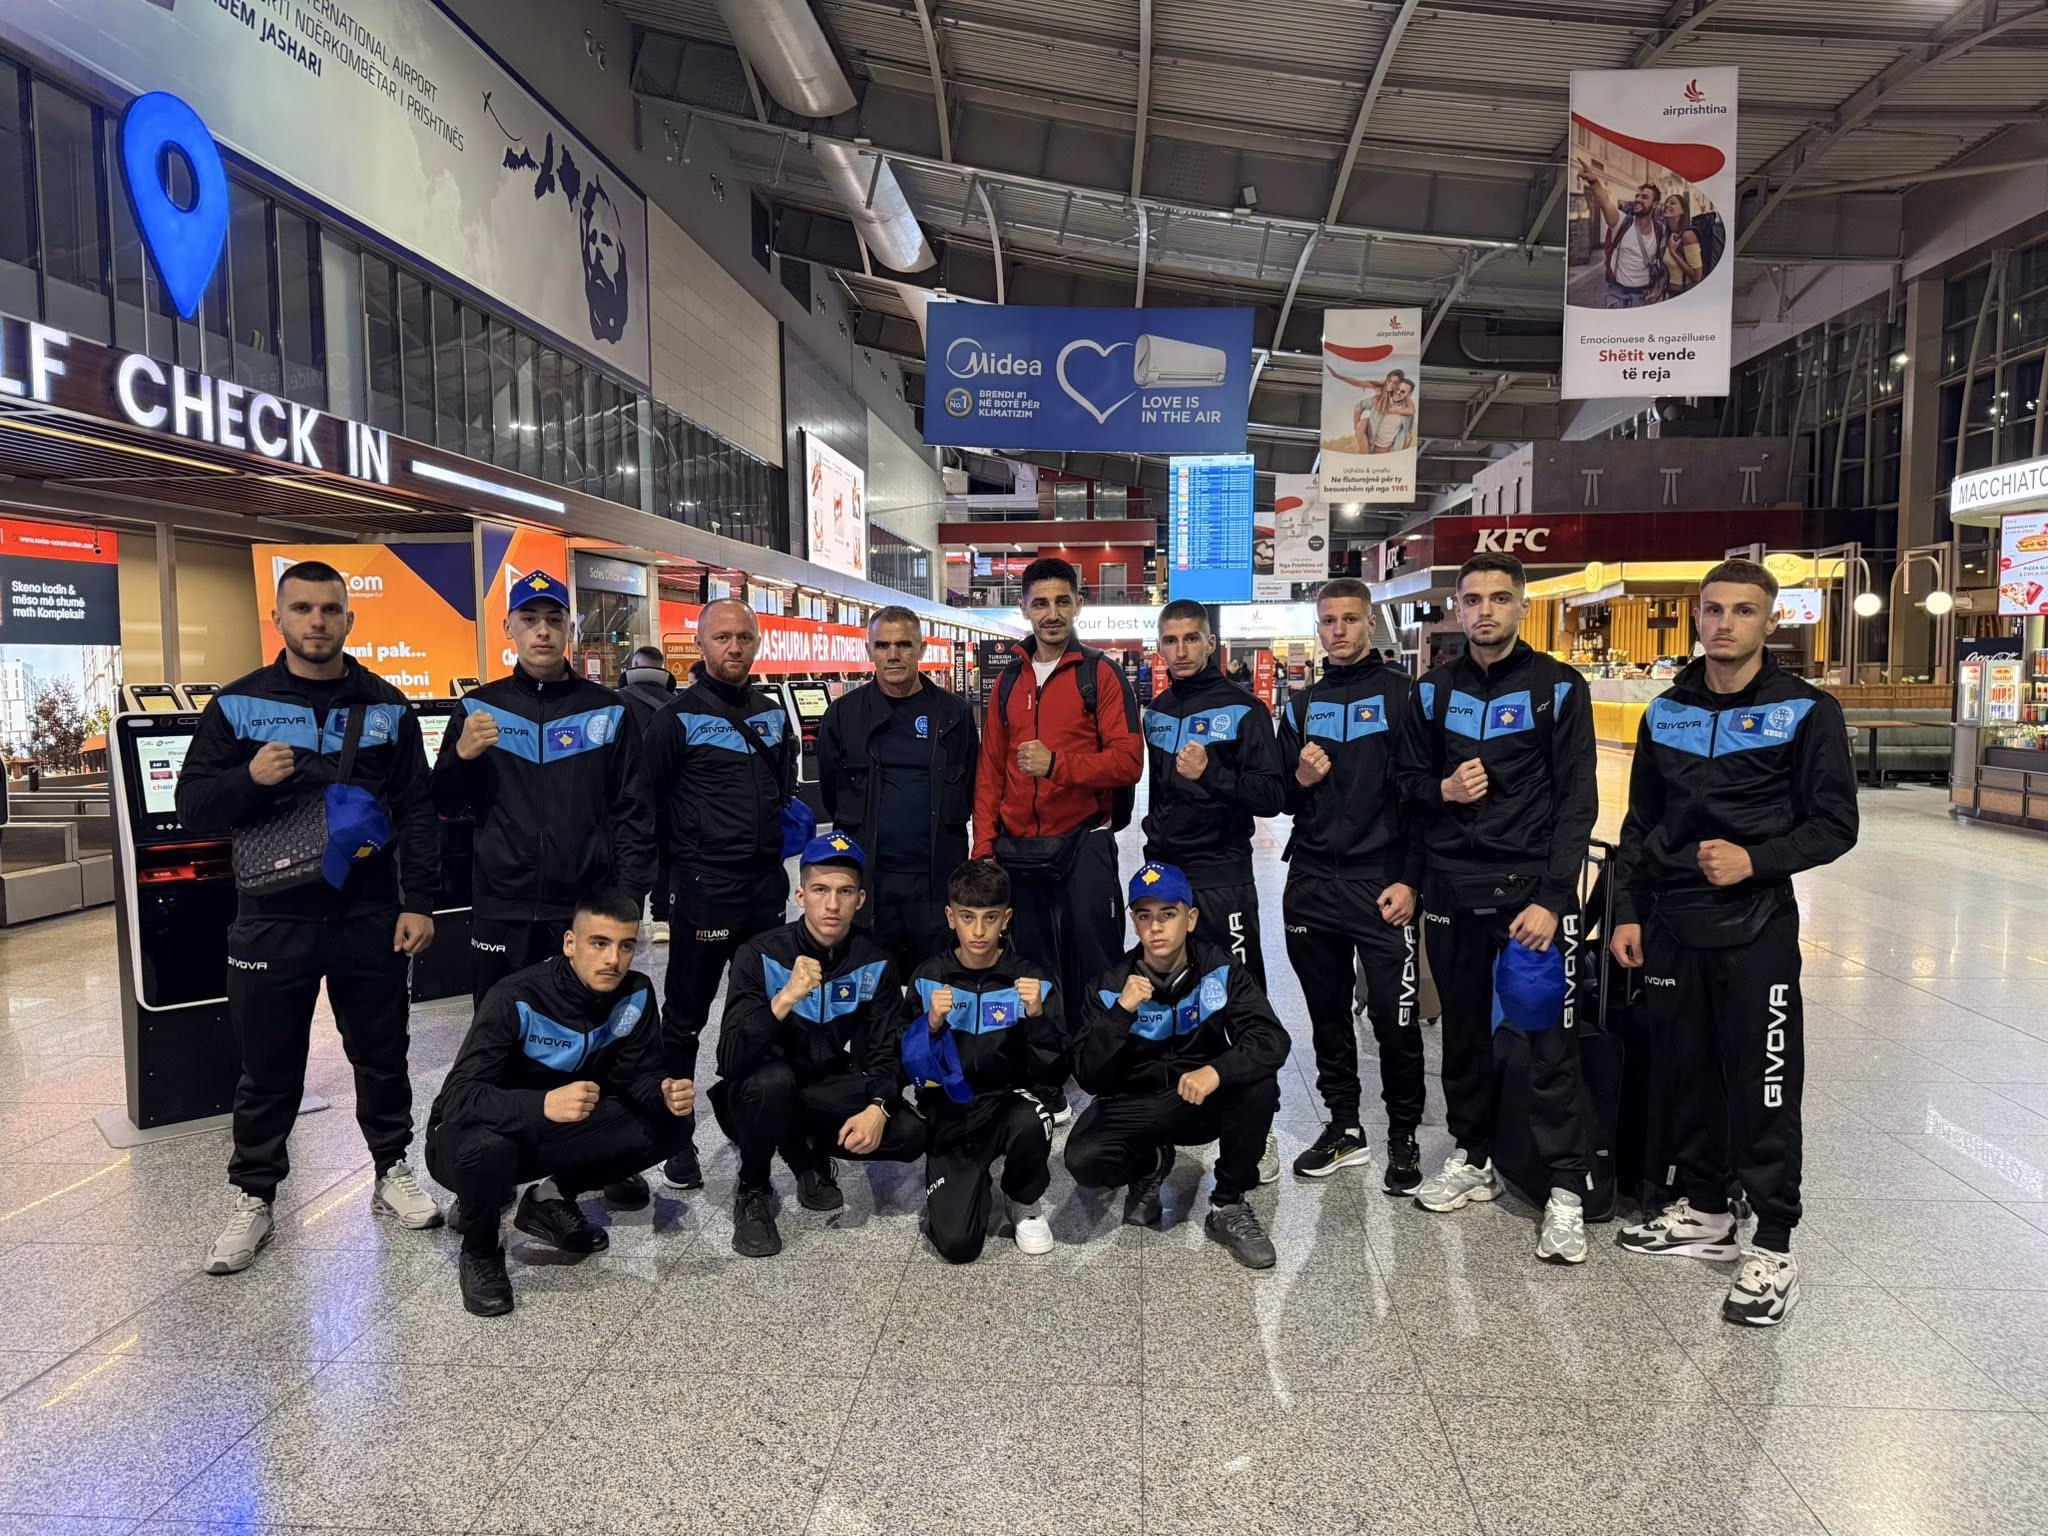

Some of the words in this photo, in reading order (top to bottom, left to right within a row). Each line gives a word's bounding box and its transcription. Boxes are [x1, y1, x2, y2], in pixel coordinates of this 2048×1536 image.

[260, 18, 321, 77] JASHARI
[306, 0, 388, 66] ERNATIONAL
[392, 56, 437, 103] AIRPORT
[295, 8, 396, 101] NDËRKOMBËTAR
[400, 89, 404, 107] I
[407, 94, 464, 152] PRISHTINËS
[1662, 104, 1728, 117] airprishtina
[1580, 335, 1645, 344] Emocionuese
[1647, 334, 1655, 343] &
[1658, 333, 1716, 344] ngazëlluese
[1599, 349, 1644, 362] Shëtit
[1648, 347, 1696, 360] vende
[956, 350, 1042, 378] Midea
[1622, 367, 1637, 380] të
[1642, 367, 1671, 382] reja
[979, 390, 1015, 399] BRENDI
[1016, 391, 1027, 399] #1
[1142, 396, 1180, 408] LOVE
[1184, 396, 1200, 408] IS
[979, 398, 993, 408] NË
[994, 398, 1020, 408] BOTË
[1020, 399, 1040, 409] PËR
[118, 354, 322, 469] CHECK
[348, 420, 390, 485] IN
[978, 409, 1033, 418] KLIMATIZIM
[1141, 411, 1158, 423] IN
[1160, 411, 1192, 423] THE
[1195, 411, 1221, 423] AIR
[1959, 466, 2048, 504] MACCHIATO
[1473, 528, 1550, 553] KFC
[12, 580, 40, 592] Skeno
[42, 582, 67, 594] kodin
[68, 584, 76, 595] &
[12, 594, 39, 605] mëso
[56, 597, 85, 607] shumë
[37, 607, 85, 620] Kompleksit
[1107, 616, 1139, 629] best
[813, 626, 828, 661] PËR
[956, 656, 964, 692] BUSINESS
[251, 716, 306, 727] GIVOVA
[1657, 720, 1702, 730] GIVOVA
[153, 783, 173, 791] chair
[695, 929, 729, 938] FITLAND
[1398, 925, 1416, 1027] GIVOVA
[1562, 914, 1579, 1029] GIVOVA
[529, 1034, 572, 1049] GIVOVA
[1764, 984, 1789, 1108] GIVOVA
